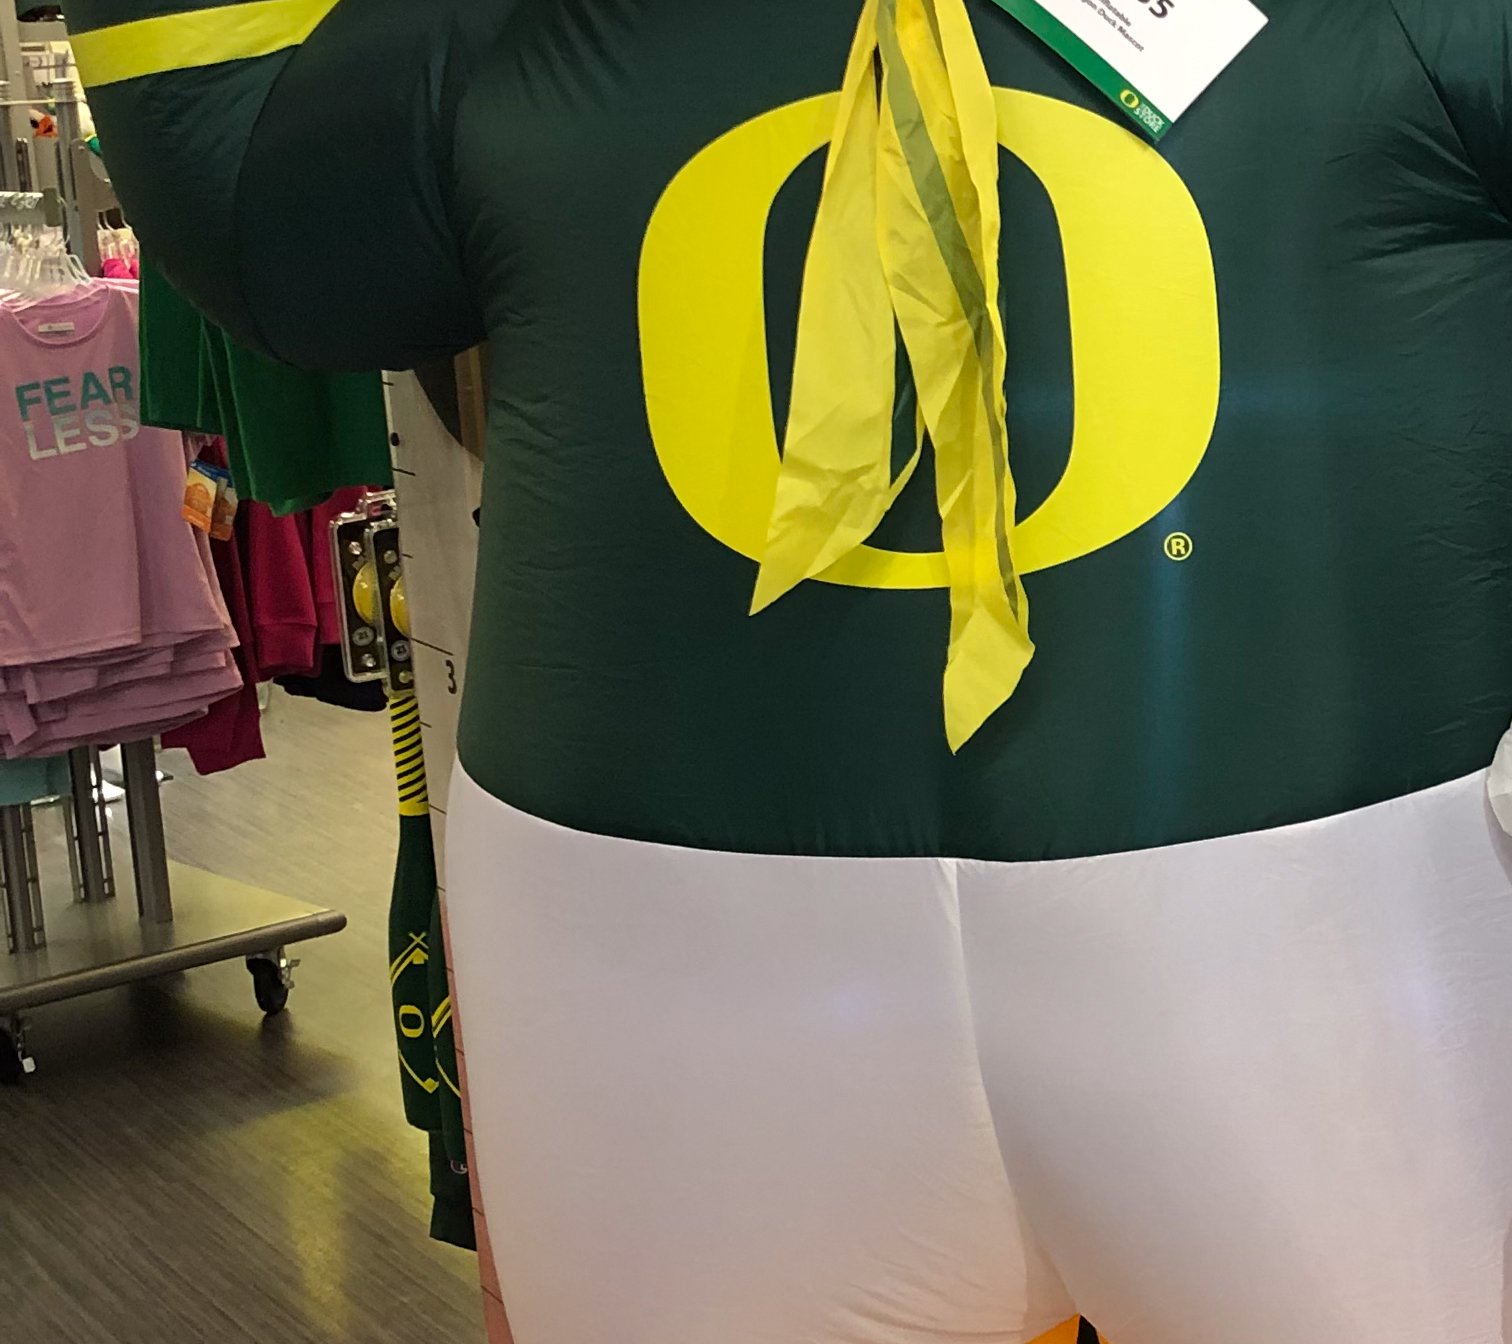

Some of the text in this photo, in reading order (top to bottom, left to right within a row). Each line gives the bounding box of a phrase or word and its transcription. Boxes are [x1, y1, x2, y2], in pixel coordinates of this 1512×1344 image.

[1097, 5, 1118, 29] Duck
[1117, 24, 1145, 52] Mascot
[15, 365, 134, 422] FEAR
[24, 405, 140, 460] LESS
